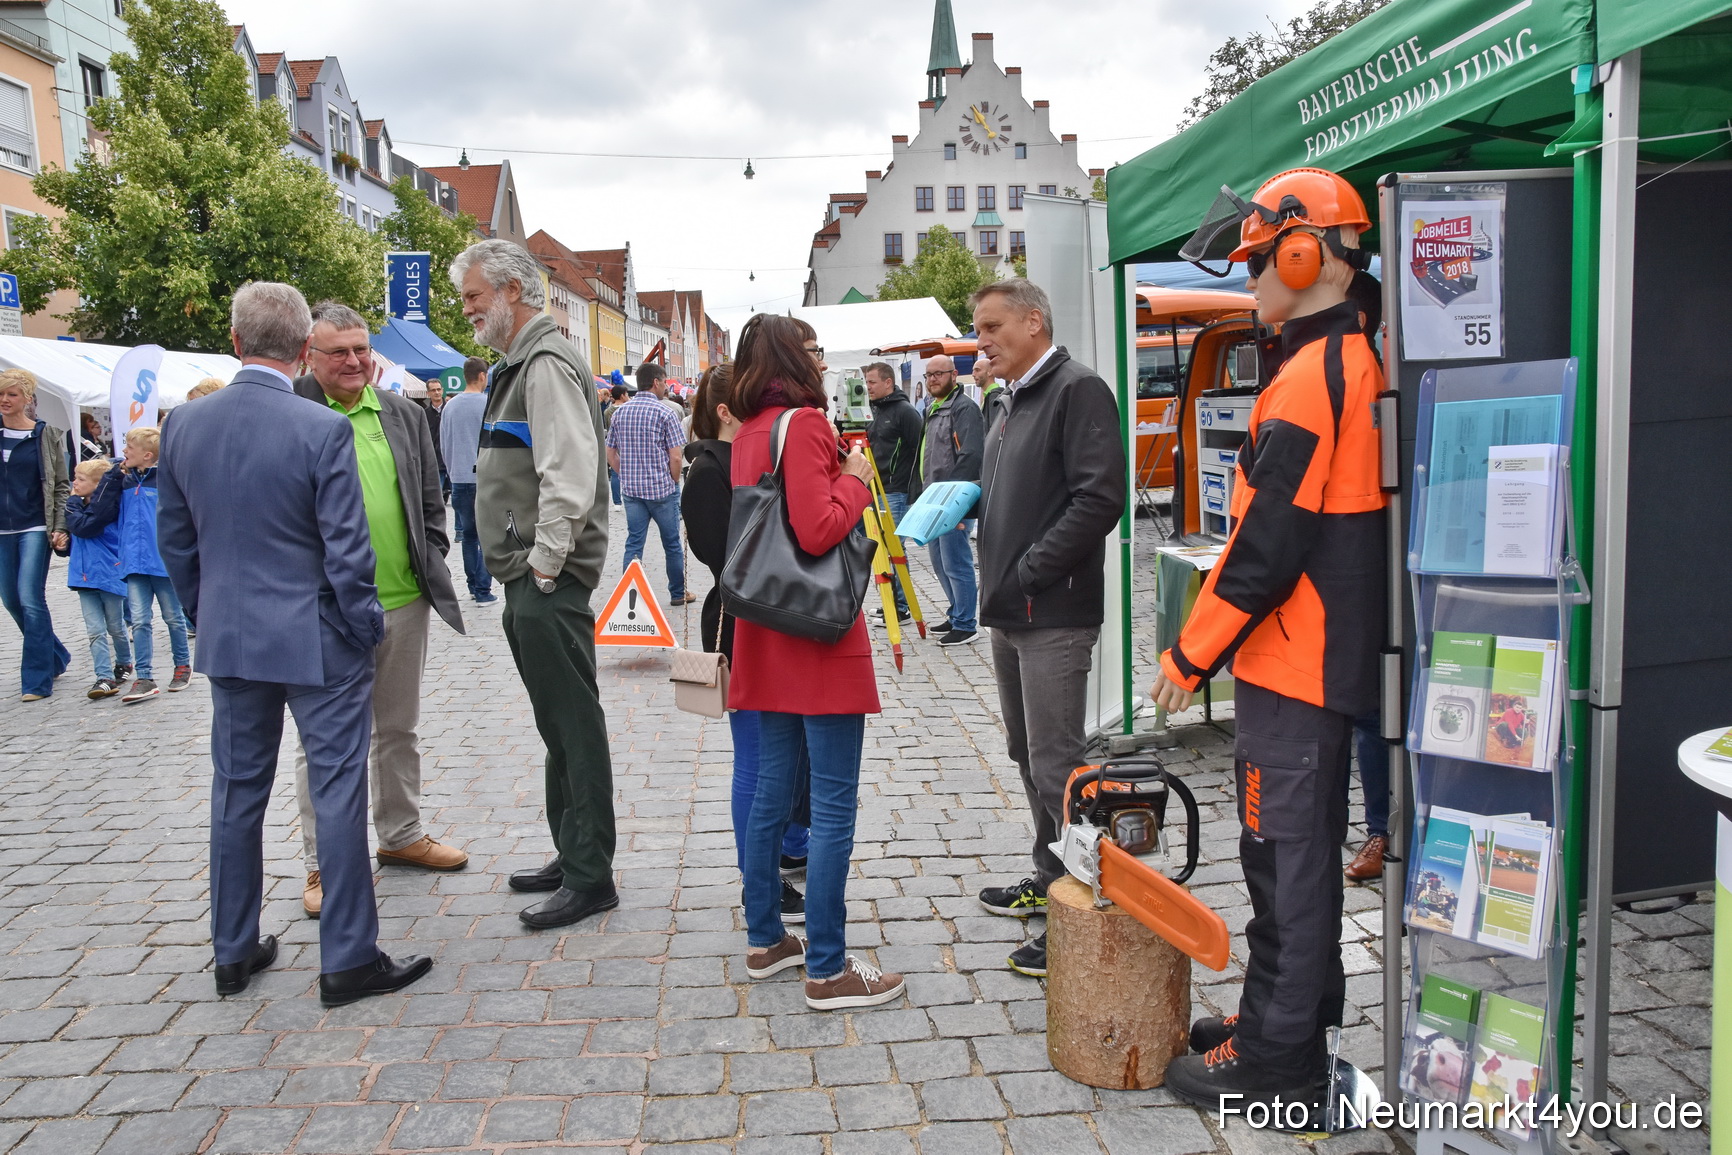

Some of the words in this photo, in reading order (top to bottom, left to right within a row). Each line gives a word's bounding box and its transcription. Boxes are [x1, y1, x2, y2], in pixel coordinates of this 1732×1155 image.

[1298, 35, 1427, 125] BAYERISCHE
[1304, 28, 1538, 162] FORSTVERWALTUNG
[1418, 219, 1469, 240] JOBMEILE
[1415, 242, 1472, 259] NEUMARKT
[1445, 261, 1469, 277] 2018
[0, 277, 13, 303] P
[406, 261, 421, 308] POLES
[1464, 322, 1492, 346] 55
[447, 375, 462, 390] D
[608, 622, 655, 635] Vermessung
[1244, 765, 1261, 832] STIHL
[1075, 837, 1088, 851] STIHL
[1142, 892, 1164, 914] STIHL
